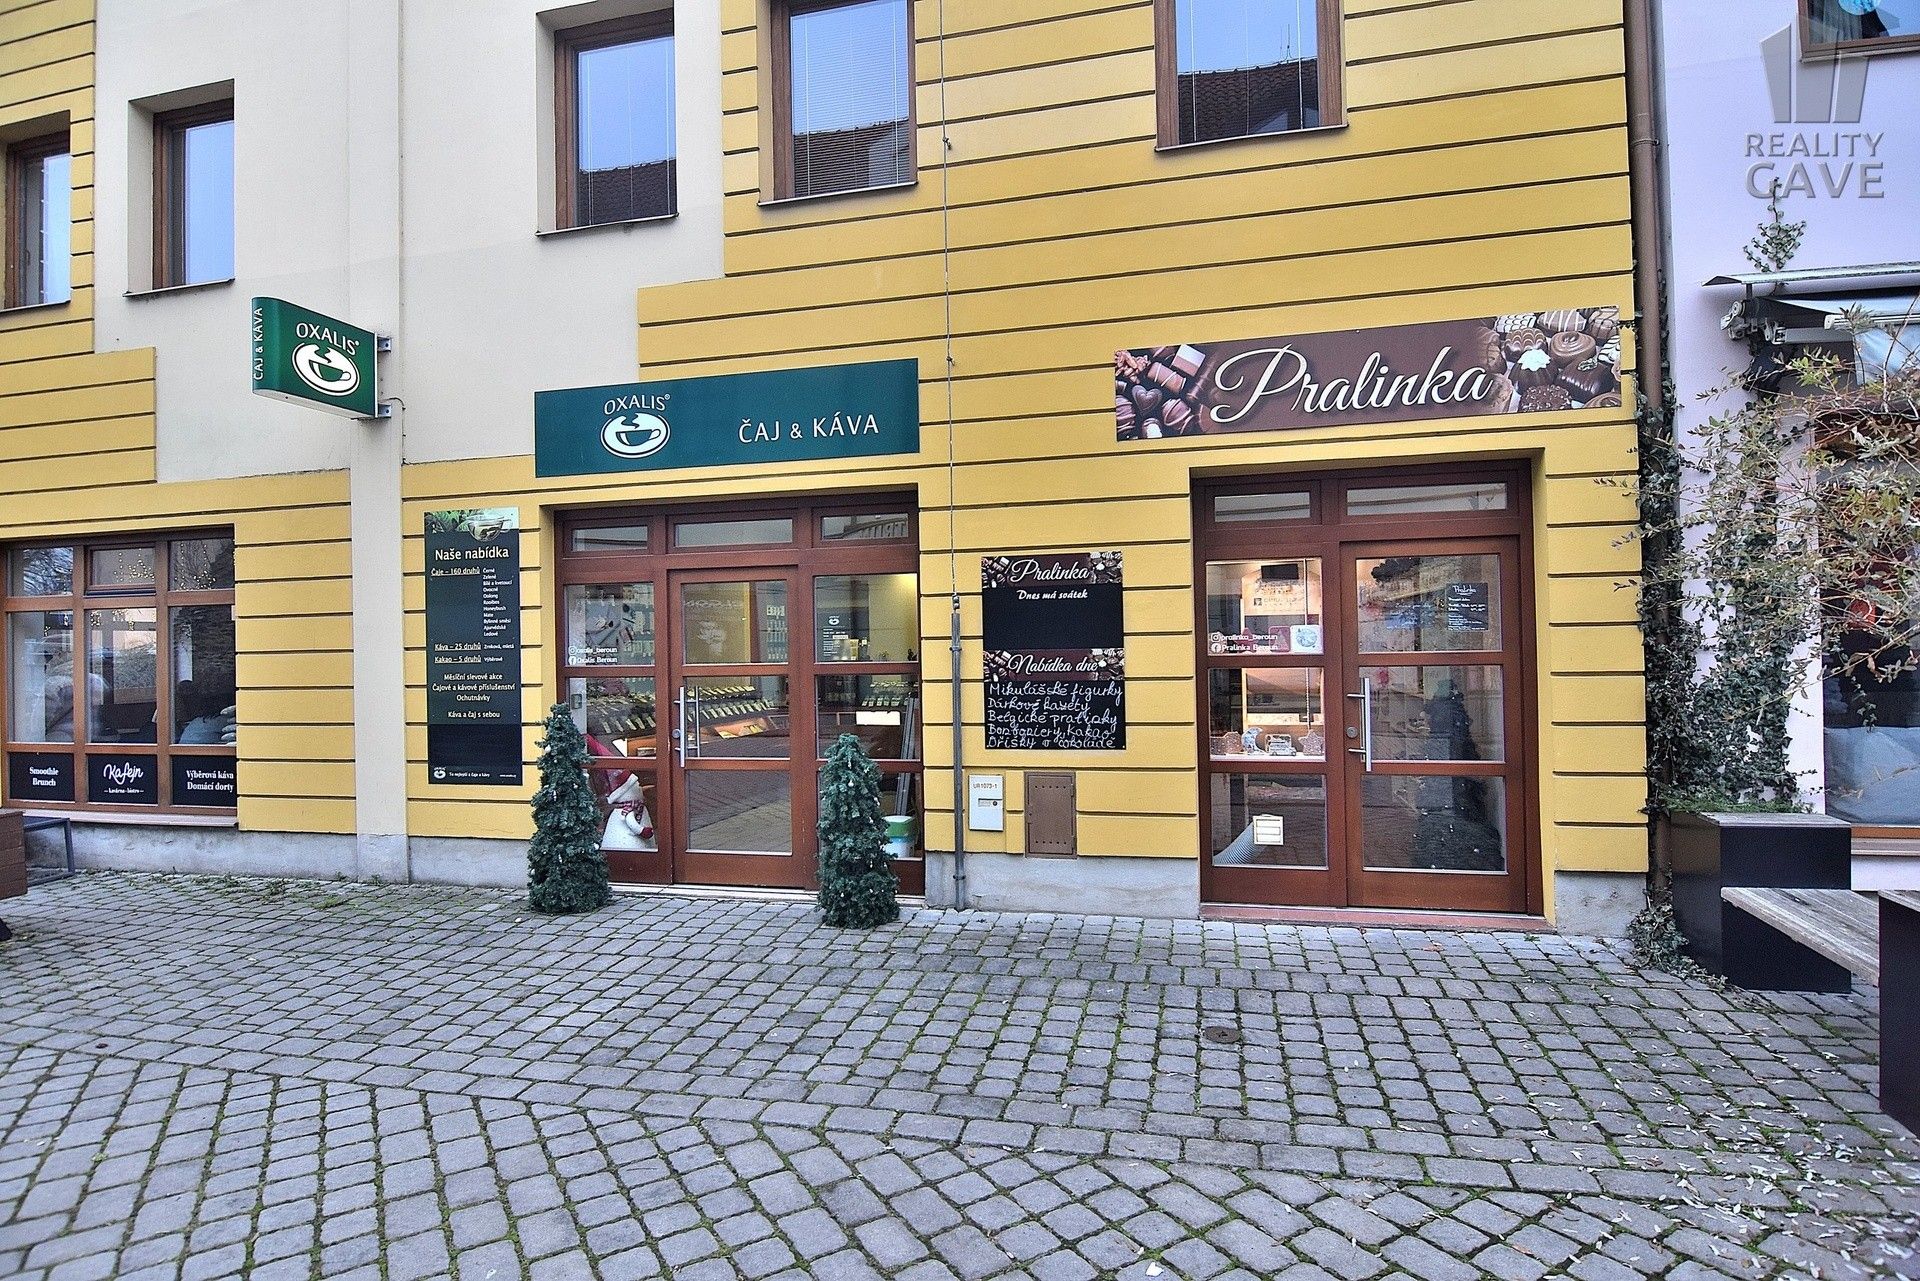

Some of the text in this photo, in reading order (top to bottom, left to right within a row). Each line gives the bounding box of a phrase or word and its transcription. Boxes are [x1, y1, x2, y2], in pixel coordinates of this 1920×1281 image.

[1210, 343, 1497, 424] Pralinka
[738, 411, 879, 444] ČAJ & KÁVA
[435, 546, 510, 560] Naše nabídka
[431, 568, 444, 576] Čaje
[462, 566, 480, 574] druhů
[1010, 558, 1090, 583] Pralinka
[1016, 588, 1088, 600] Dnes má svátek
[1008, 654, 1098, 674] Nabídka dne
[432, 683, 452, 692] Čajové
[478, 682, 516, 692] příslušenství
[989, 681, 1122, 706] Mikulášské figurky
[988, 697, 1042, 710] Dárkové
[468, 710, 476, 718] čaj
[988, 708, 1118, 732] Belgické pralinky
[29, 766, 59, 776] Smoothie
[103, 762, 144, 785] Kafejn
[186, 770, 216, 780] Výběrová
[32, 778, 56, 786] Brunch
[187, 780, 234, 792] Domácí dorty
